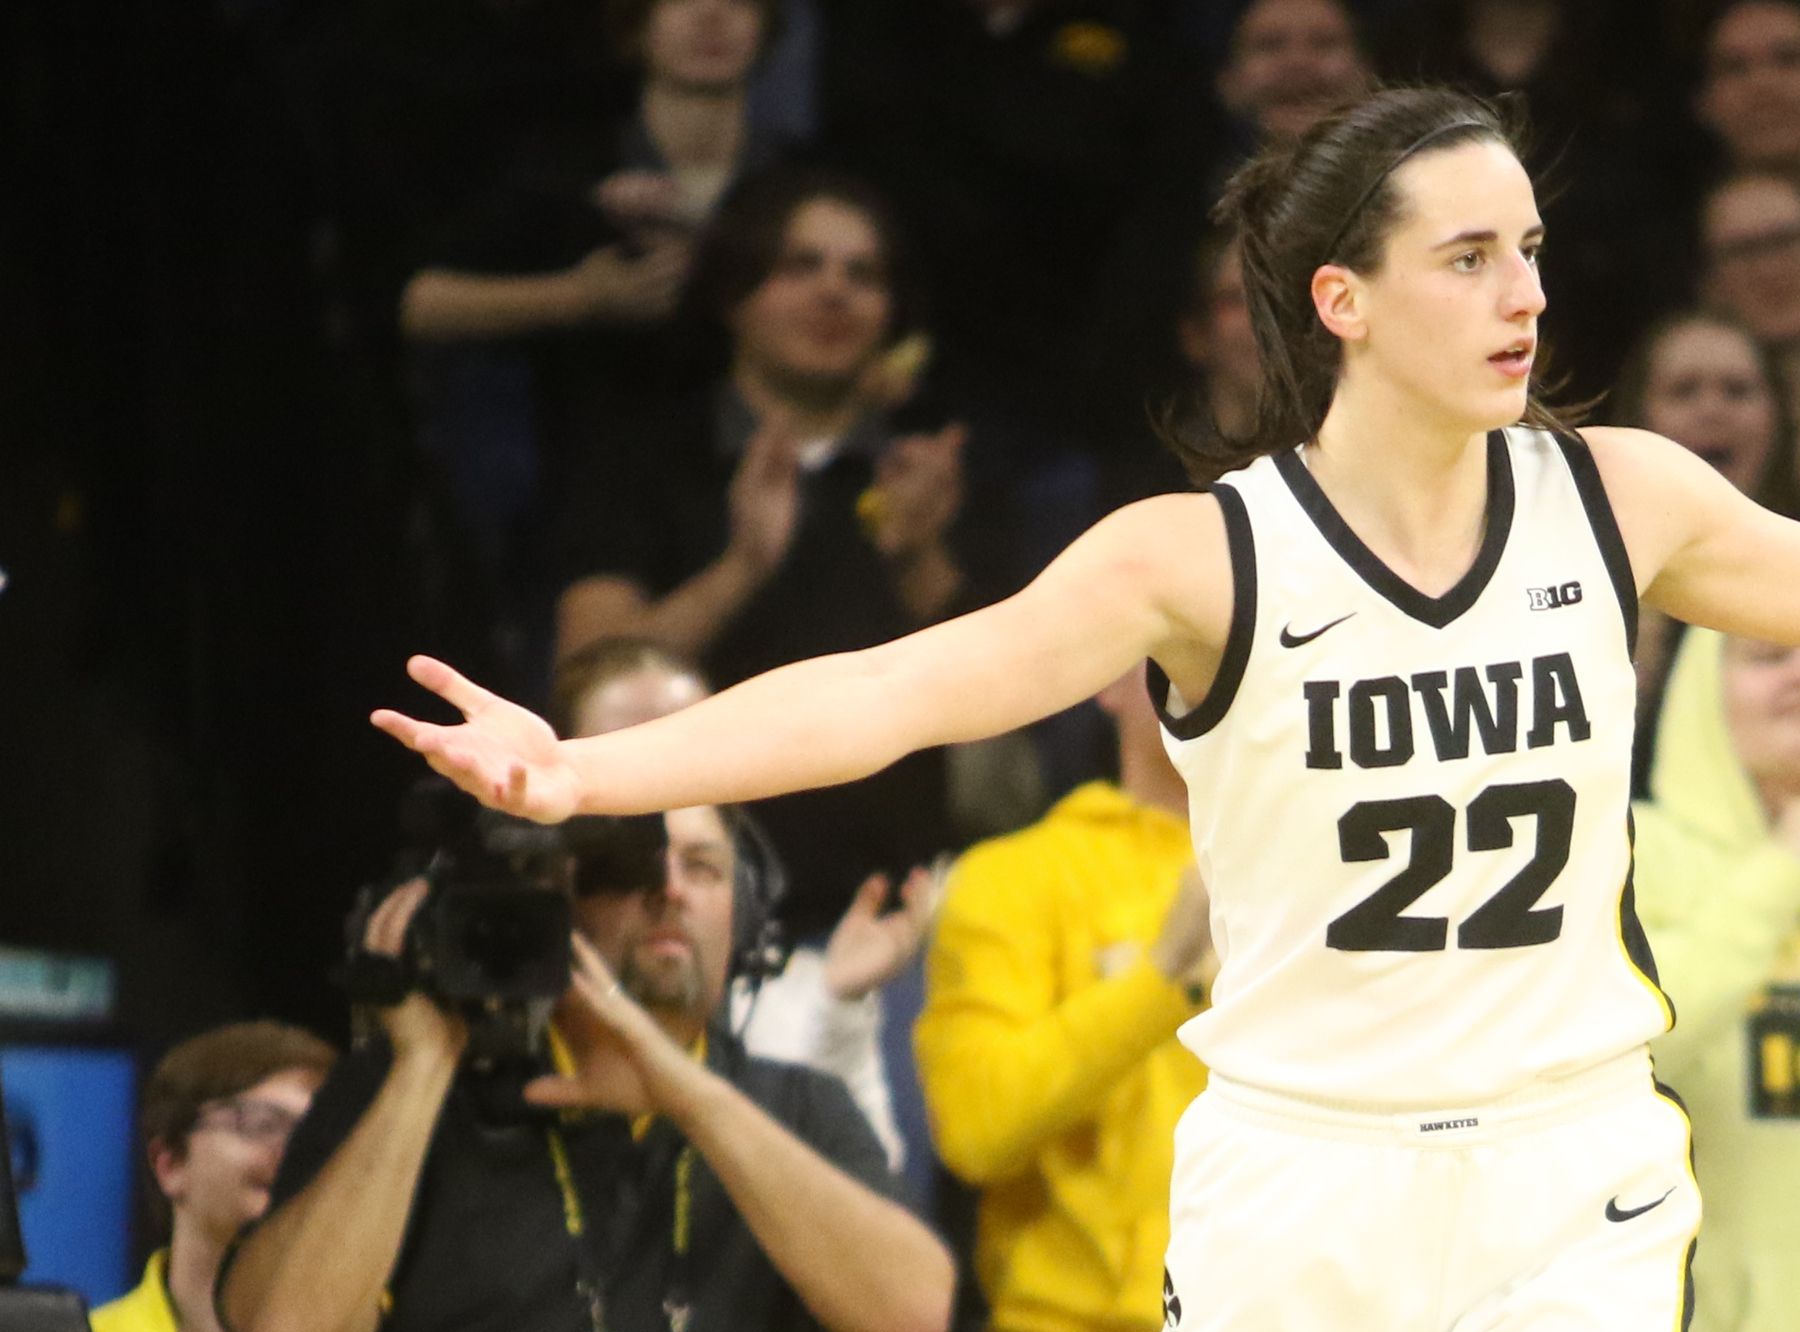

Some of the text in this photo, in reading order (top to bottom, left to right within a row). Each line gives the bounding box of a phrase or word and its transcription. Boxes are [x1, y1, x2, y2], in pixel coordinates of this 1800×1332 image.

[1303, 652, 1591, 770] IOWA
[1326, 778, 1577, 951] 22
[1420, 1118, 1479, 1132] HAWKEYES
